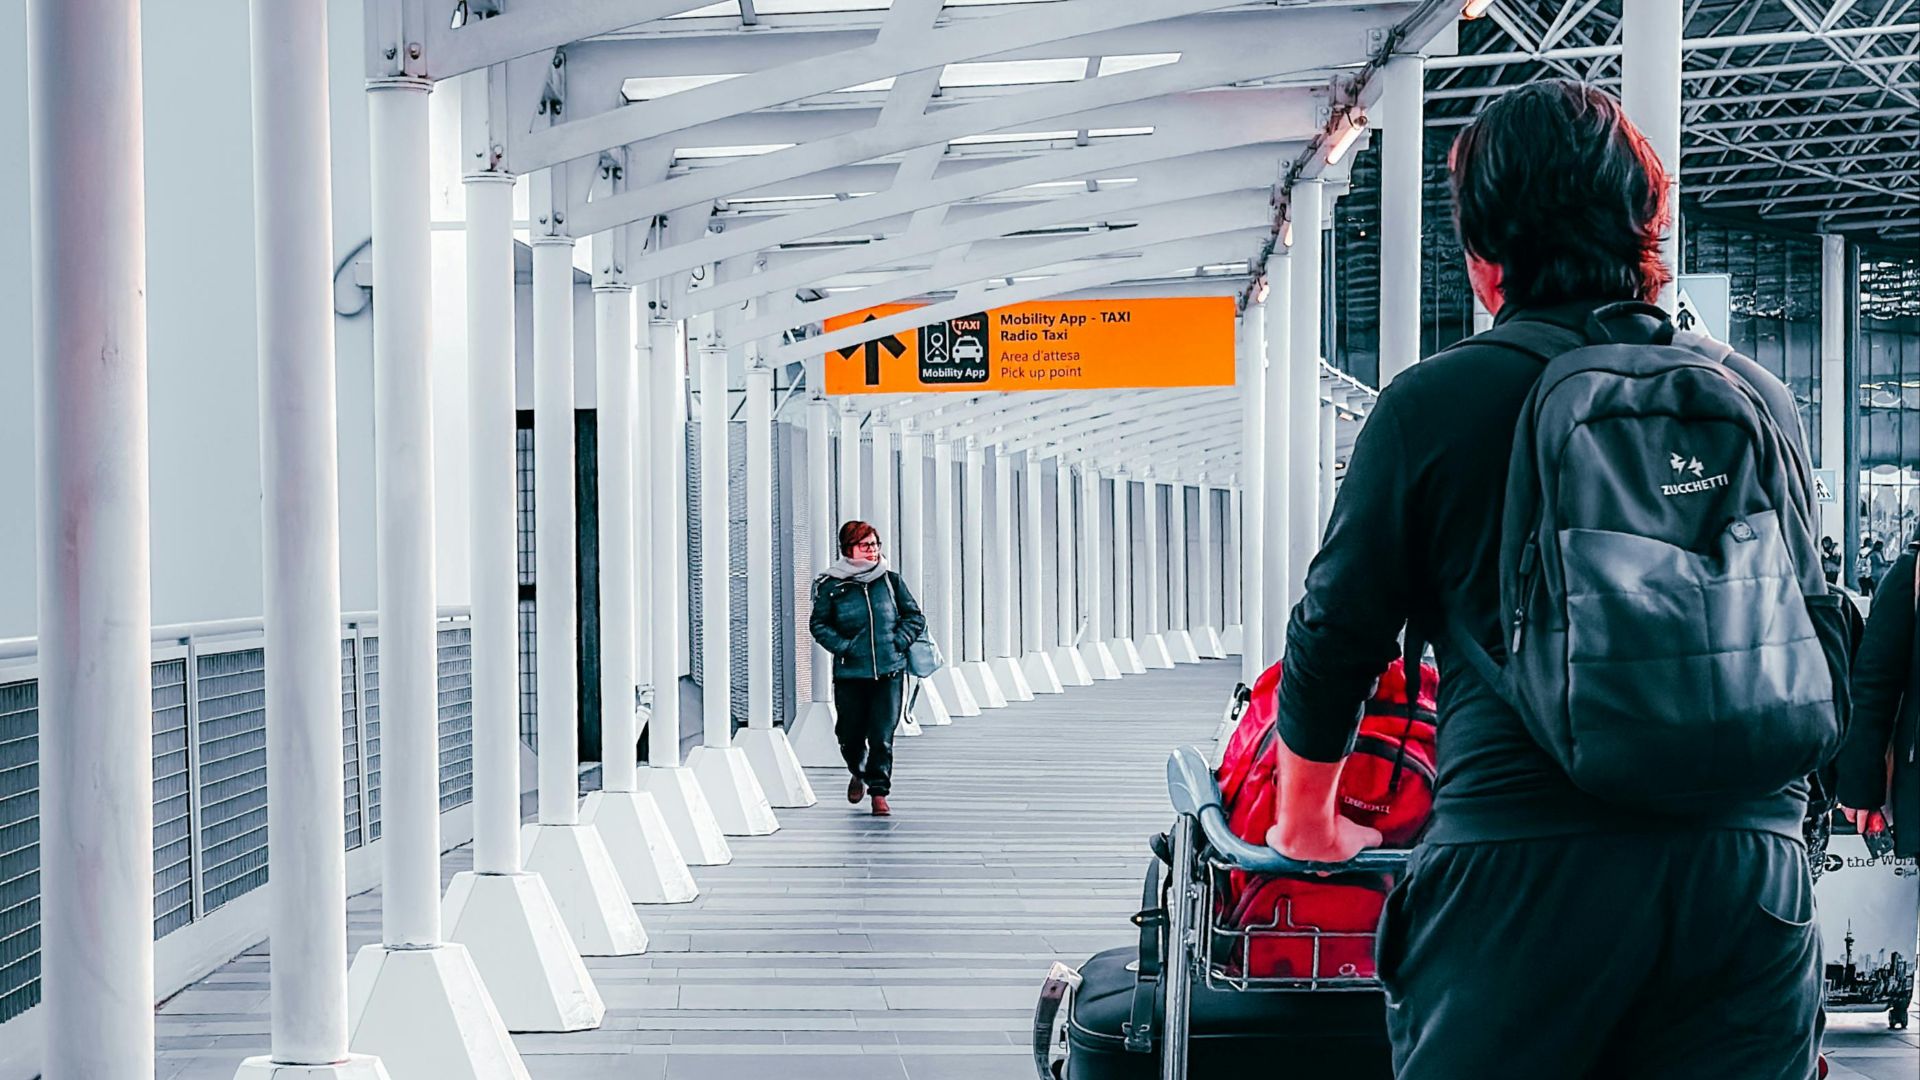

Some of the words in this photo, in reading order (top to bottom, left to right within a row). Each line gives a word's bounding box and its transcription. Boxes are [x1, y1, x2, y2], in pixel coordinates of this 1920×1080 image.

[956, 320, 981, 330] TAXI
[1000, 313, 1055, 327] Mobility
[1060, 313, 1087, 326] App
[1100, 311, 1131, 323] TAXI
[1000, 330, 1038, 342] Radio
[1042, 329, 1068, 341] Taxi
[1001, 351, 1029, 362] Area
[1032, 350, 1081, 361] d'attesa
[922, 367, 963, 379] Mobility
[965, 367, 986, 379] App
[1001, 367, 1025, 378] Pick
[1029, 370, 1046, 381] up
[1049, 366, 1082, 380] point
[1661, 474, 1729, 495] ZUCCHETTI
[1847, 856, 1875, 867] the
[1881, 854, 1918, 866] Worl
